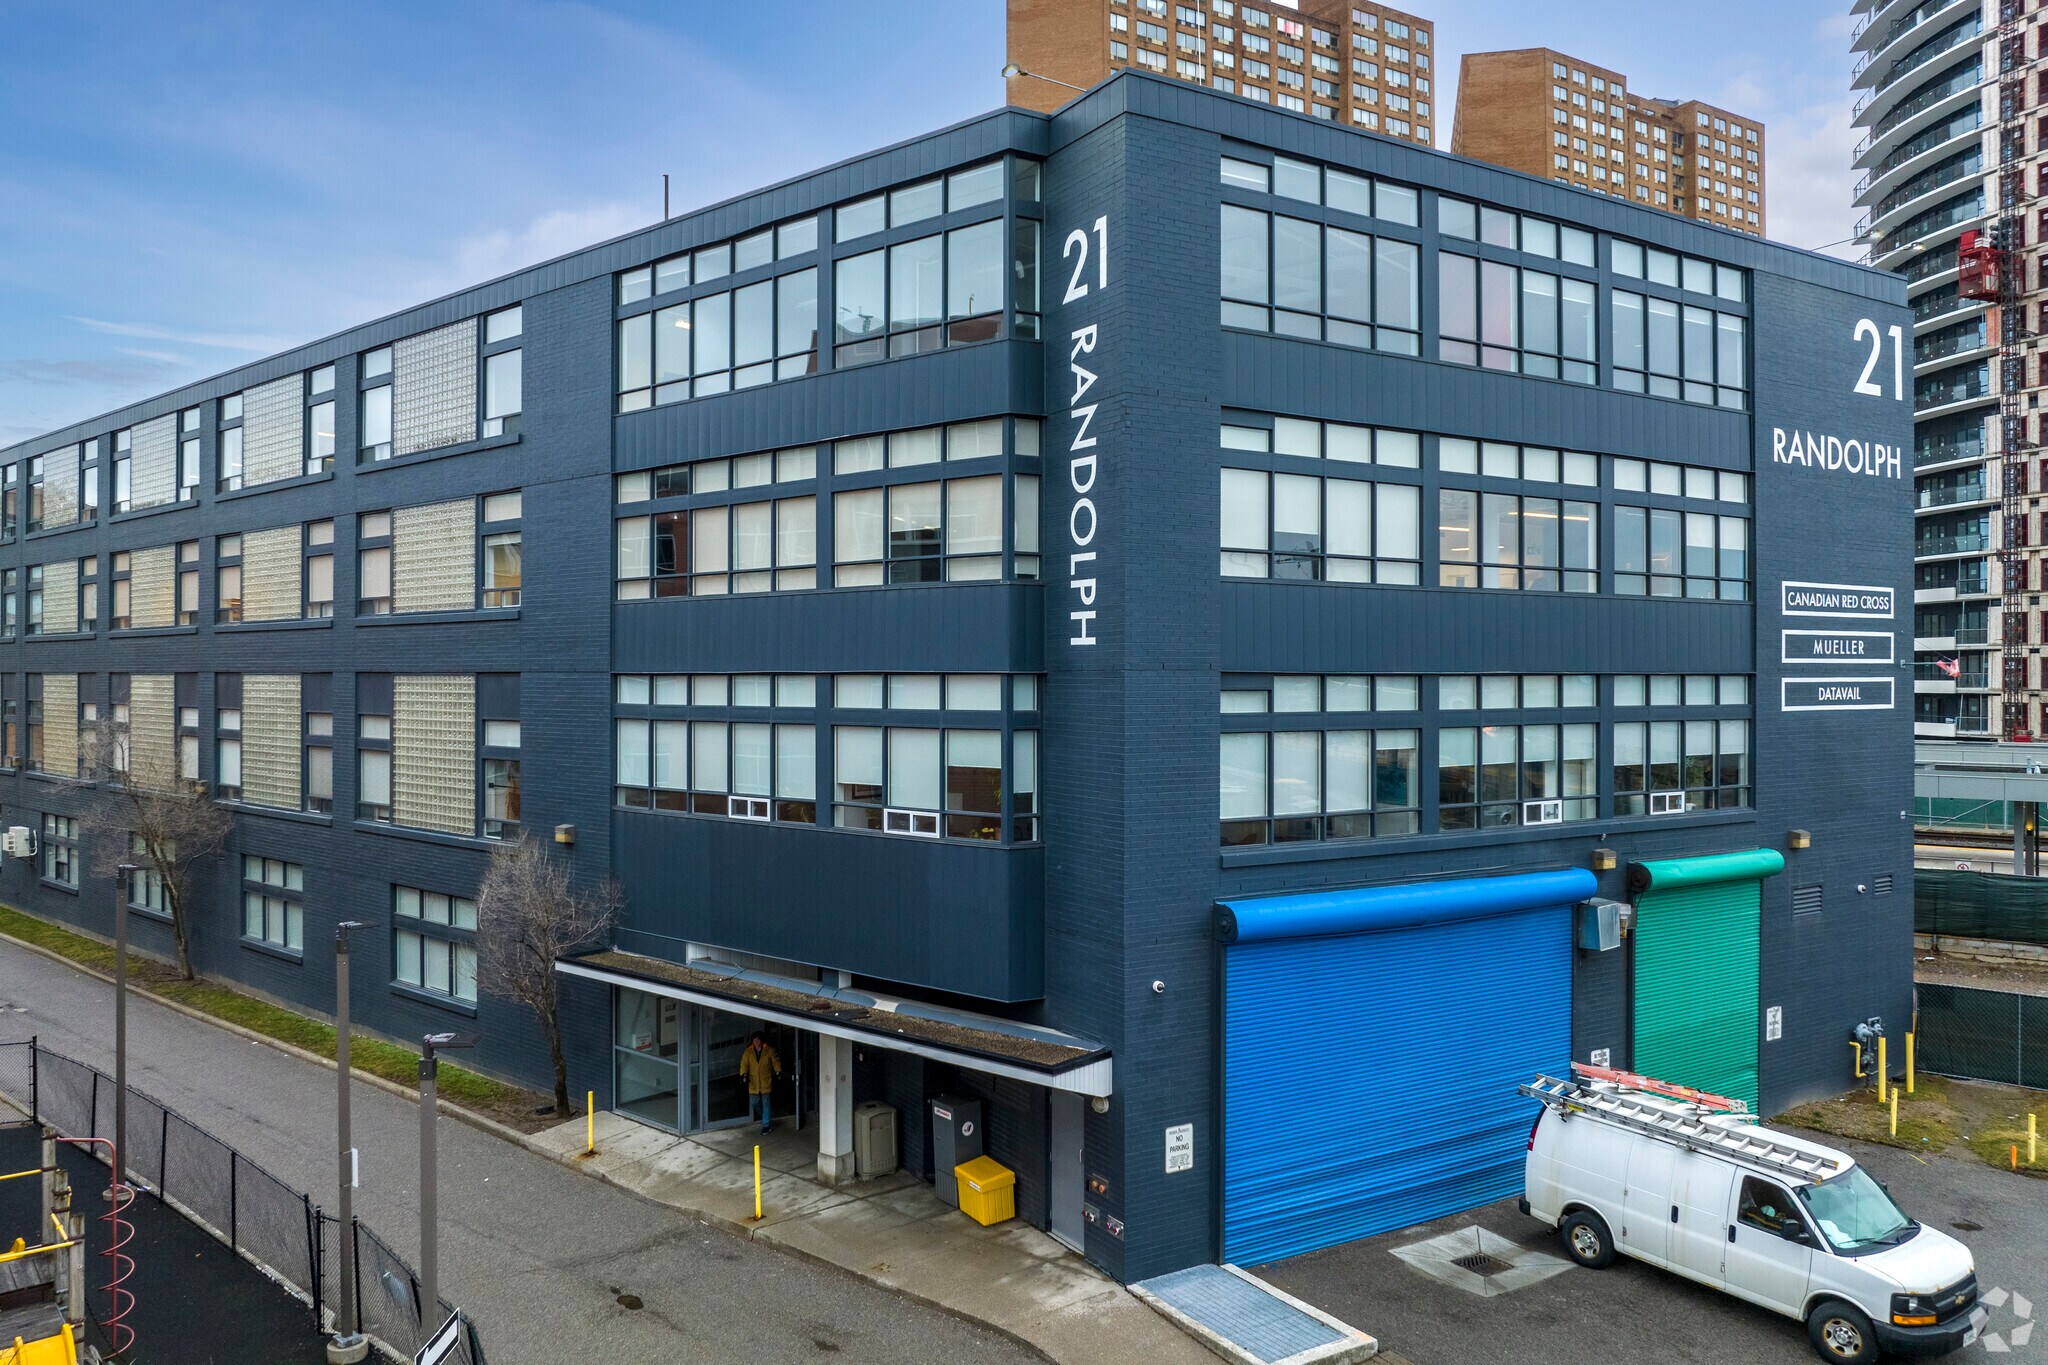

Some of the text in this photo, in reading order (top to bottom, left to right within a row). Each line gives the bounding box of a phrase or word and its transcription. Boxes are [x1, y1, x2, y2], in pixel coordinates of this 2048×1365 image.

[1062, 214, 1108, 305] 21
[1853, 318, 1903, 401] 21
[1773, 427, 1901, 480] RANDOLPH
[1070, 323, 1098, 646] RANDOLPH
[1787, 591, 1890, 610] CANADIAN RED CROSS
[1813, 639, 1865, 655] MUELLER
[1818, 686, 1861, 701] DATAVAIL
[1170, 1143, 1189, 1153] PARKING
